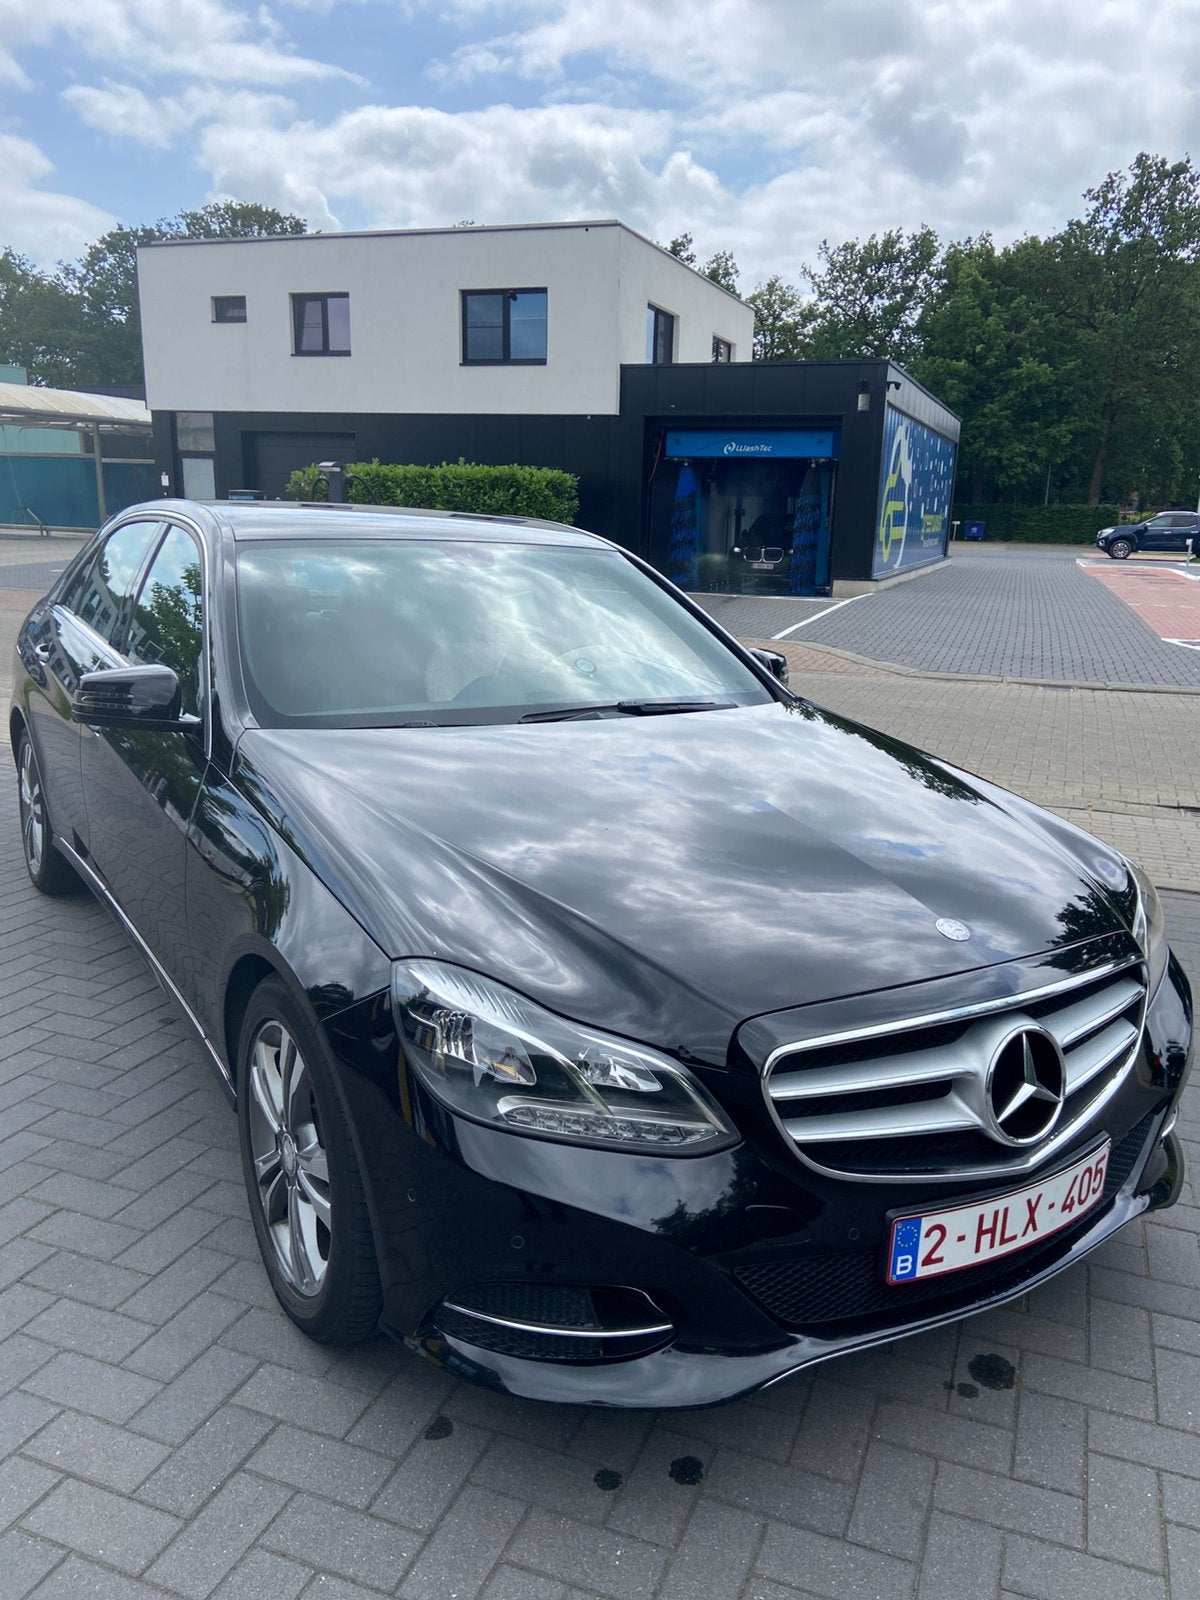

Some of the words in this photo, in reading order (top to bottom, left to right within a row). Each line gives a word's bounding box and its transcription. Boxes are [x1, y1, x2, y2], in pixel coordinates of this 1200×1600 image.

[735, 444, 773, 452] WashTec
[921, 1153, 1107, 1267] 2-HLX-405
[896, 1254, 913, 1275] B
